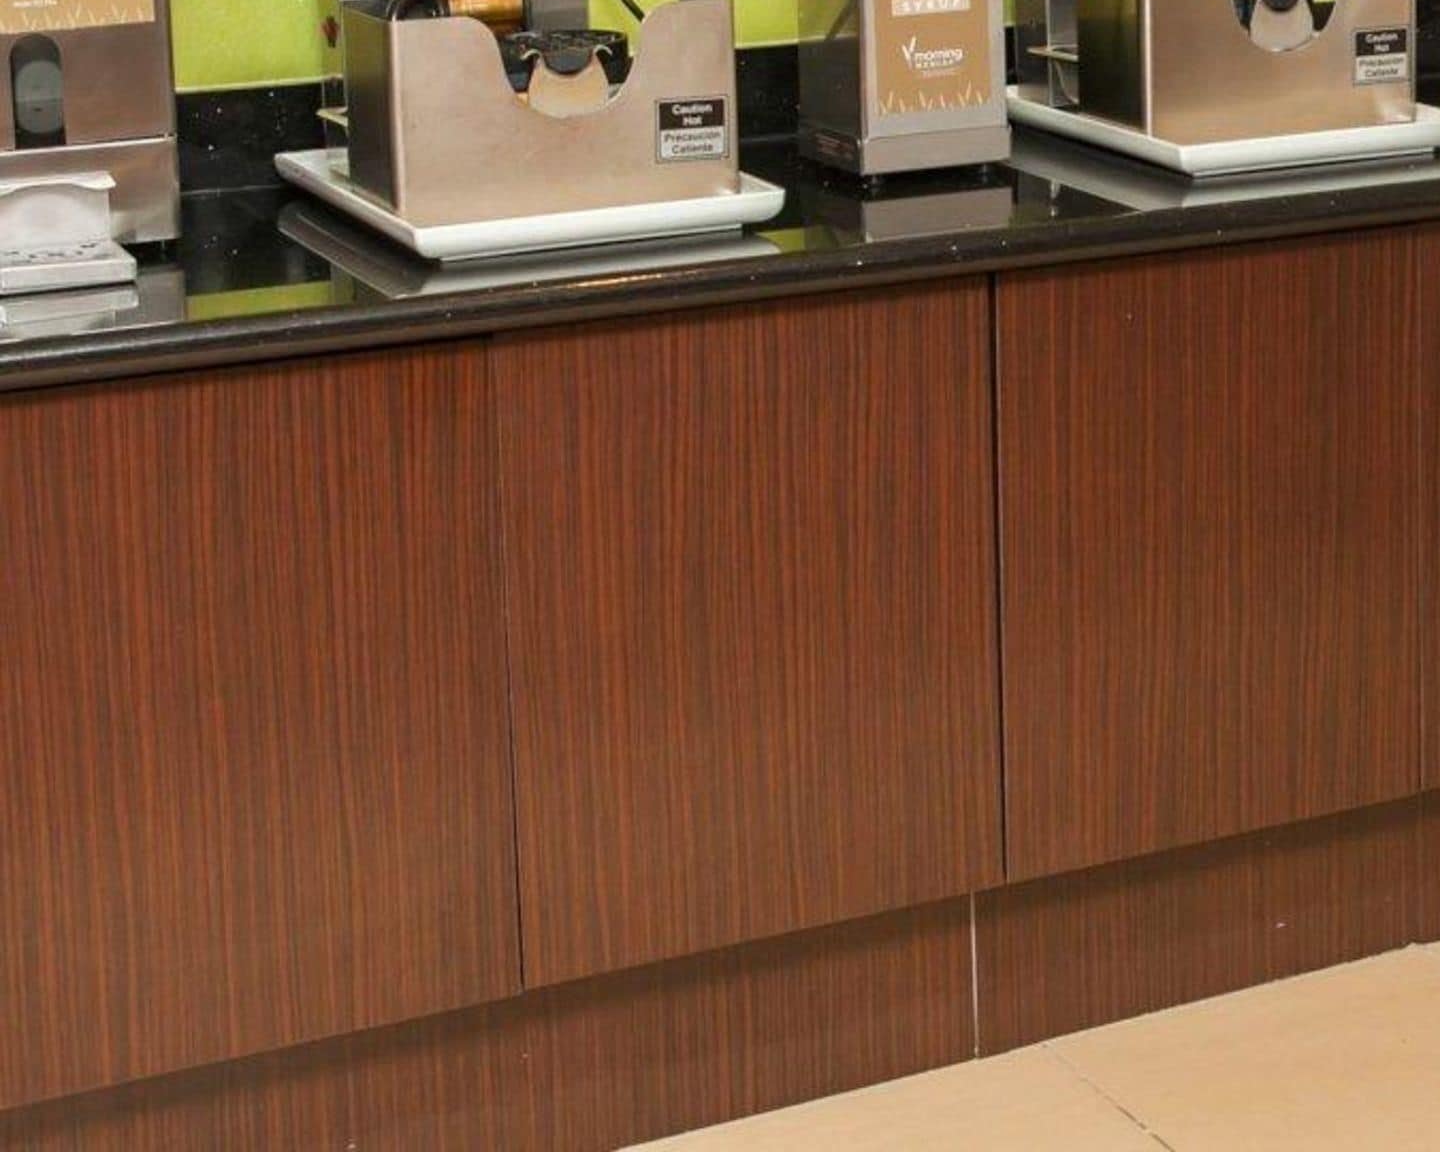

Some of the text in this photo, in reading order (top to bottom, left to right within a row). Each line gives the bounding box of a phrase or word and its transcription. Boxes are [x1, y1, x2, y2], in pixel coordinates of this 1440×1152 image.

[671, 104, 713, 116] Caution
[682, 116, 703, 126] Hot
[671, 144, 713, 154] Caliente
